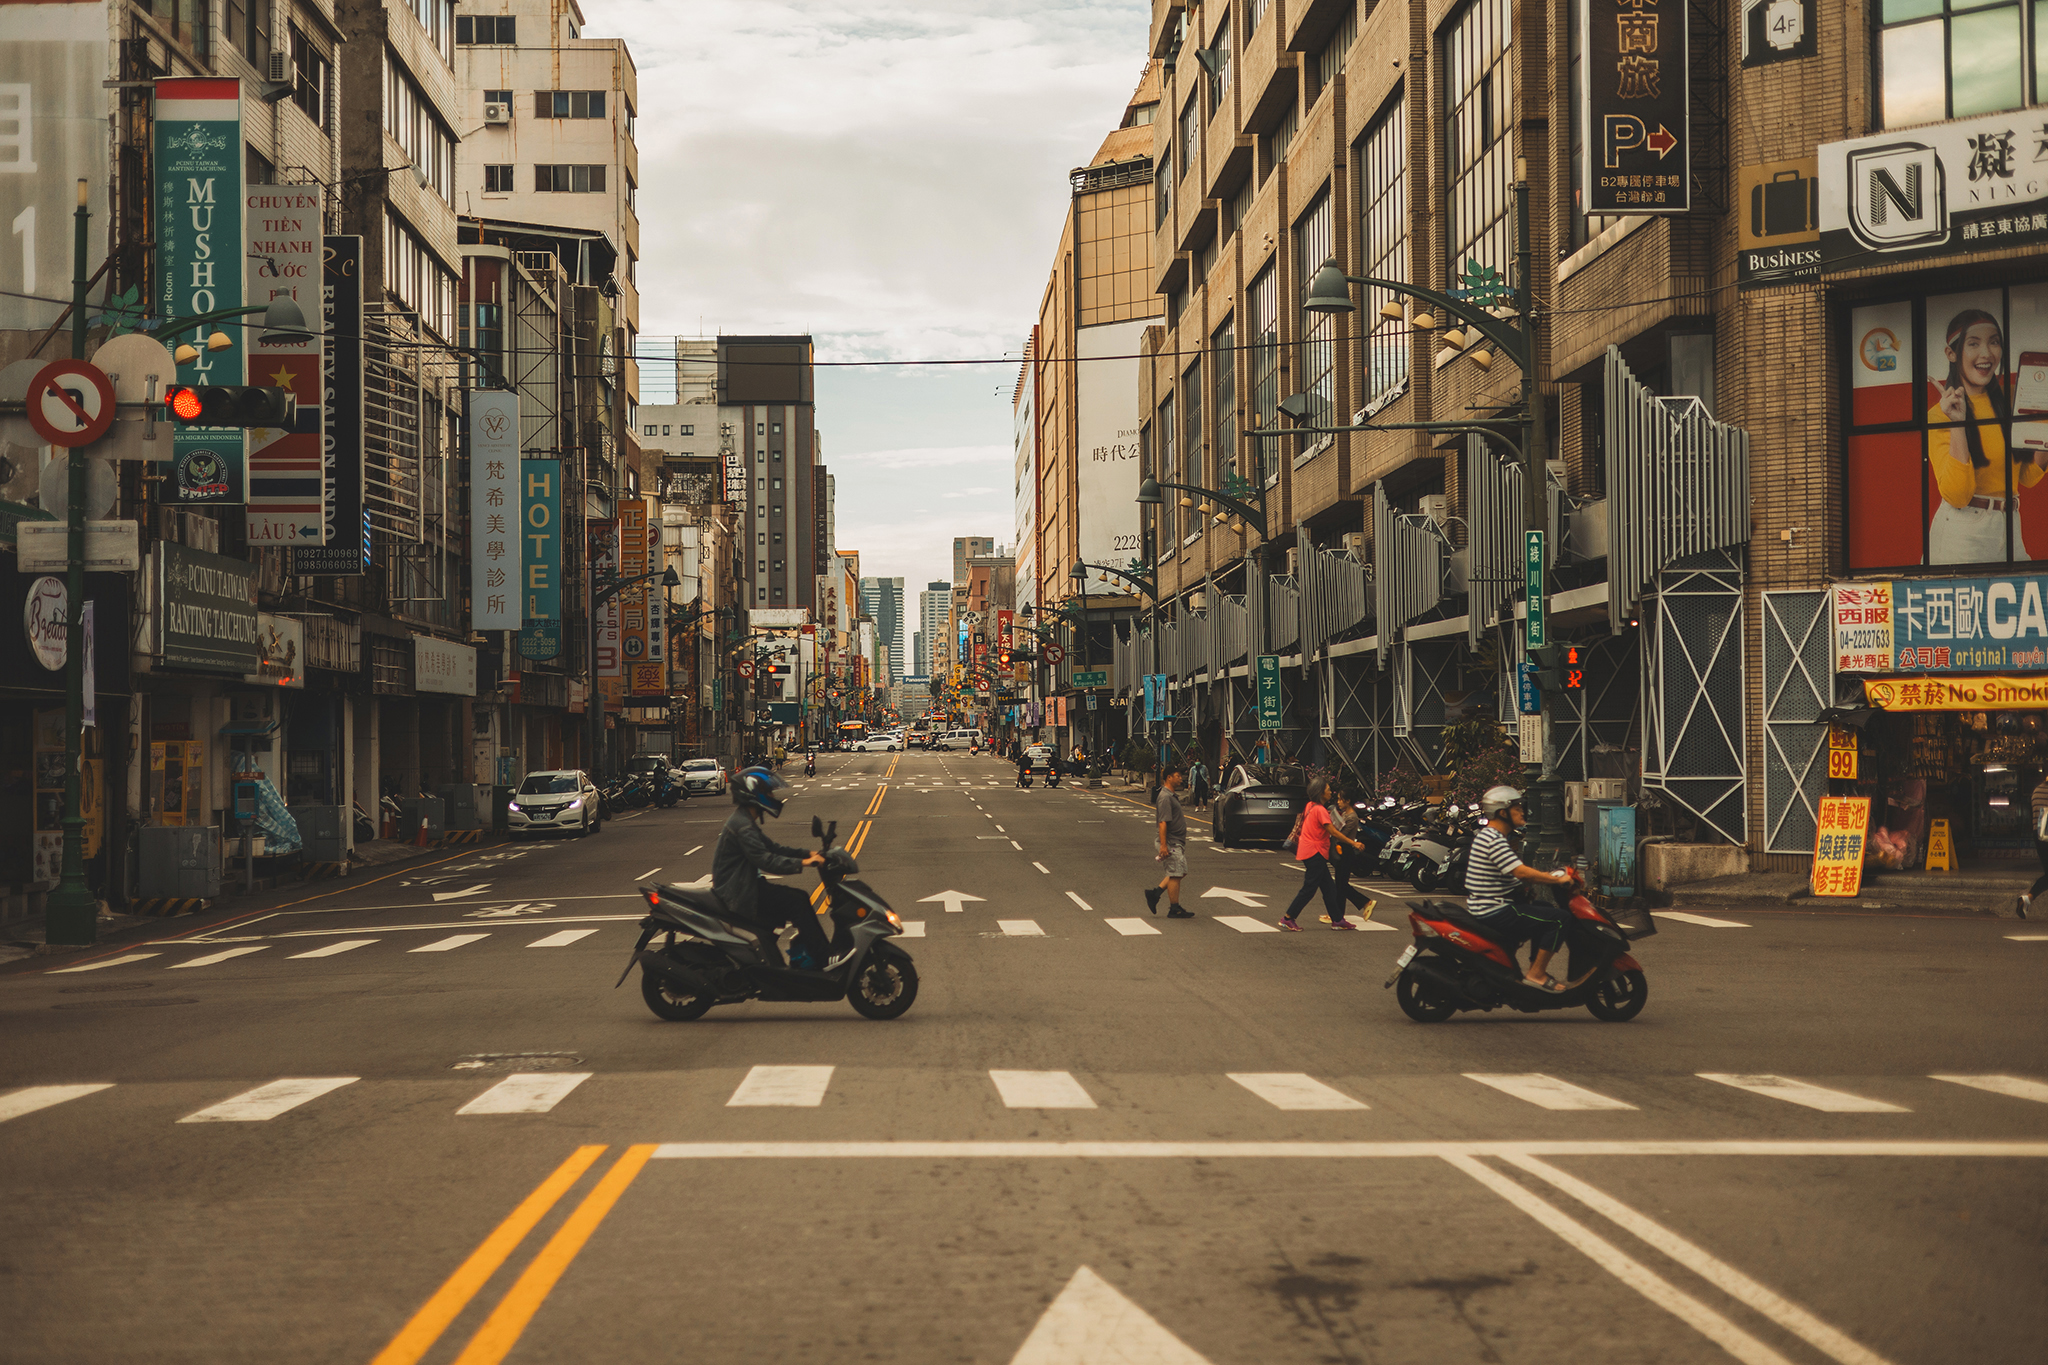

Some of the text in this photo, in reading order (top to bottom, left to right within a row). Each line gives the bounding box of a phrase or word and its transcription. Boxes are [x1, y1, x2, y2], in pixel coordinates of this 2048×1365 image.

[1773, 14, 1797, 34] 4F
[1617, 0, 1662, 99] 商旅
[1604, 114, 1646, 168] P
[1969, 180, 2039, 203] NING
[253, 241, 313, 254] NHANH
[1794, 266, 1821, 276] HOTE
[269, 286, 298, 302] PÍ
[1879, 357, 1896, 370] 24
[324, 387, 336, 468] SALON
[288, 523, 297, 540] 3
[485, 460, 505, 615] 梵希美學診所
[297, 549, 359, 559] 0927190969
[528, 473, 550, 618] HOTEL
[297, 560, 359, 570] 0985066055
[188, 564, 249, 602] PCINU TAIWAN
[1838, 588, 1889, 605] 美光
[169, 602, 256, 644] RANTING TAICHUNG
[1838, 608, 1889, 625] 西服
[1898, 586, 1984, 642] 卡西歐
[522, 638, 556, 646] 2222-5056
[522, 647, 556, 655] 2222-5057
[1840, 630, 1890, 650] 04-22327633
[1840, 654, 1889, 669] 美光商店
[1899, 646, 1951, 669] 公司貨
[1955, 647, 2007, 667] original
[637, 665, 660, 688] 藥
[1262, 657, 1276, 708] 電子街
[1900, 683, 1945, 706] 禁菸
[1950, 686, 1977, 703] No
[1261, 720, 1280, 728] 80m
[1831, 751, 1853, 777] 99
[1821, 802, 1866, 830] 換電池
[1818, 834, 1862, 861] 換錶帶
[1814, 866, 1858, 893] 修手錶
